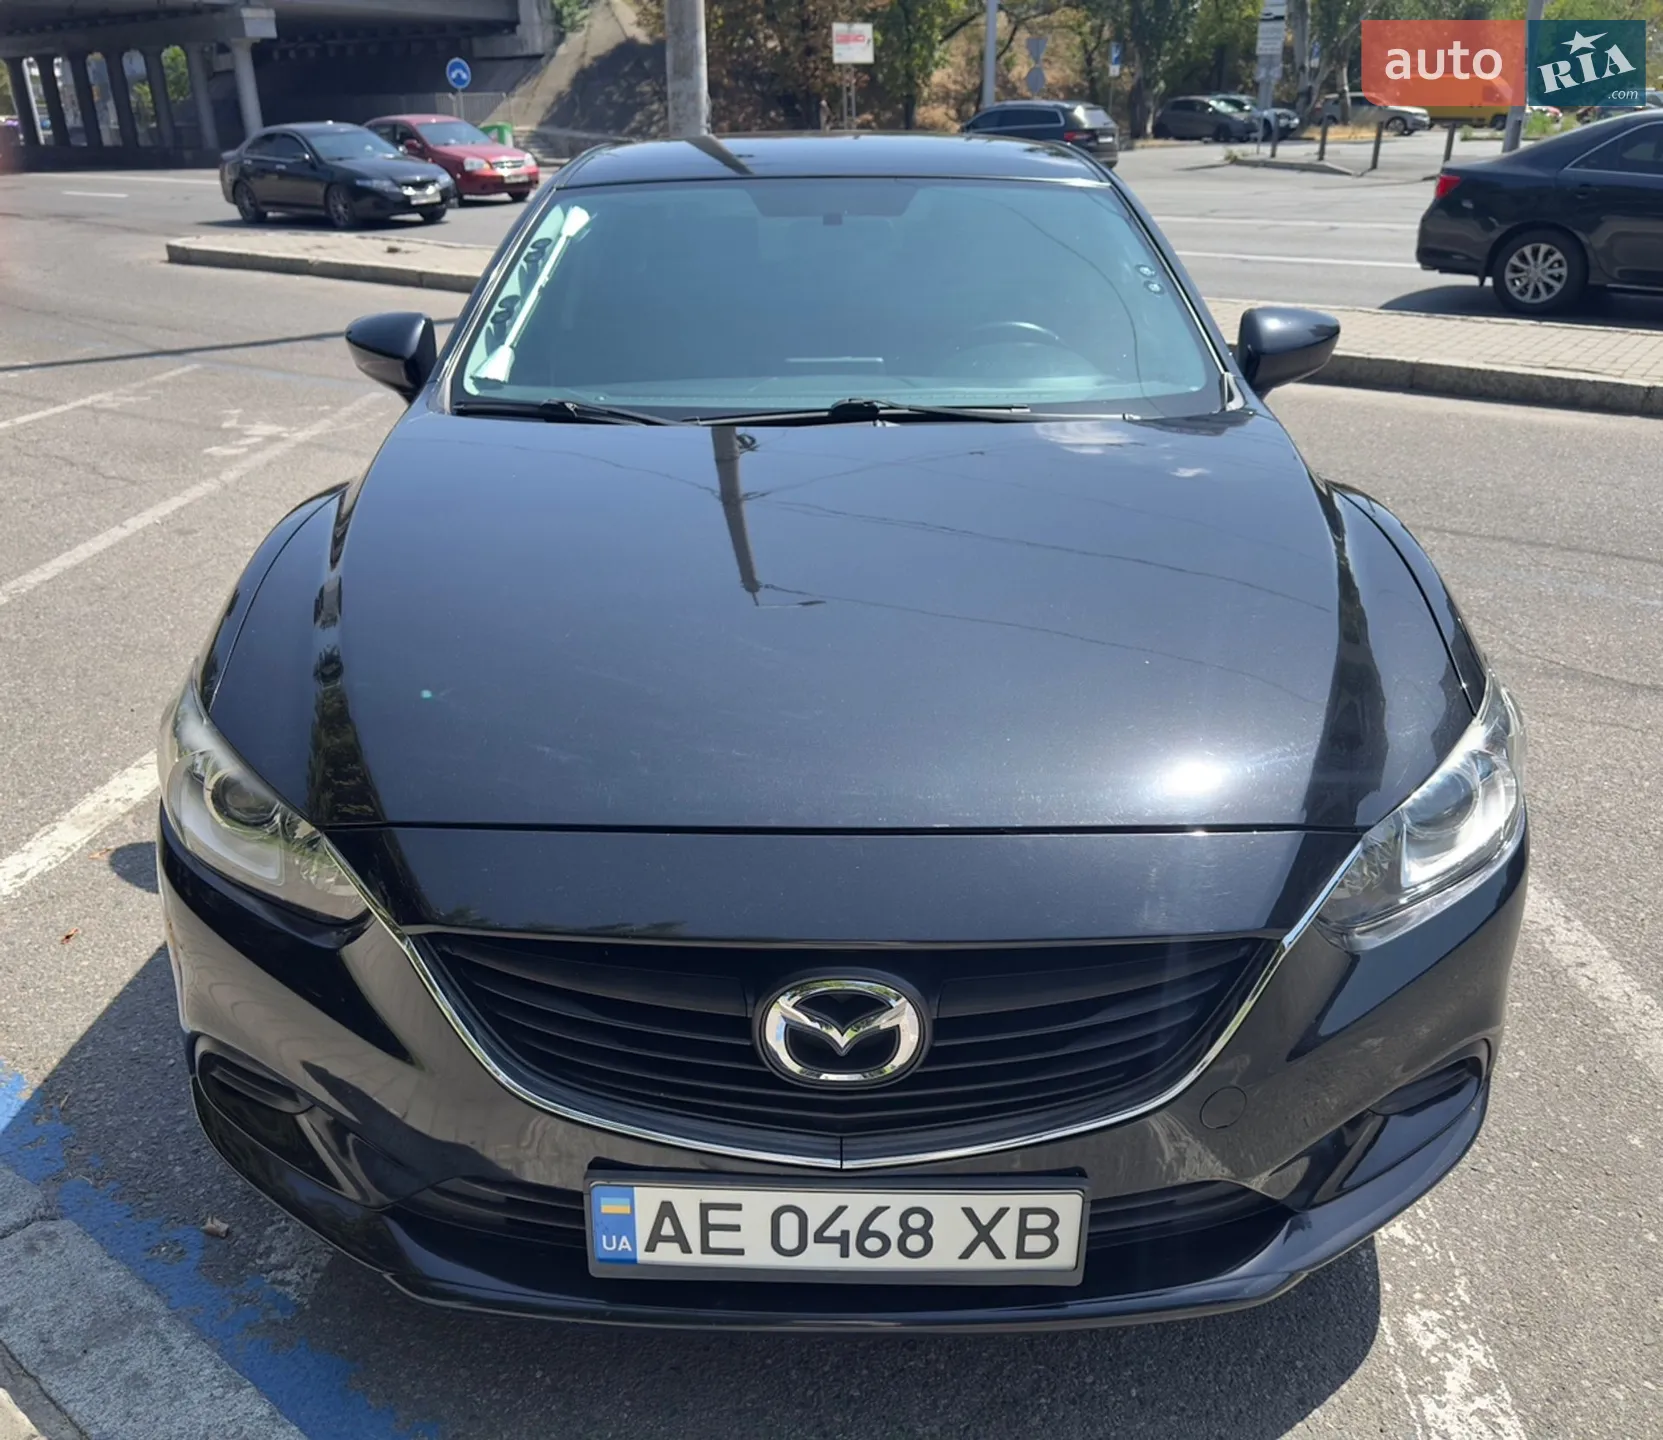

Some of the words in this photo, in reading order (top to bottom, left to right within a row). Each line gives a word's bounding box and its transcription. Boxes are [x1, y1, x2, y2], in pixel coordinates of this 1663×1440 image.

[602, 1234, 632, 1251] UA
[644, 1200, 745, 1256] AE
[770, 1204, 935, 1260] 0468
[958, 1206, 1061, 1260] XB
